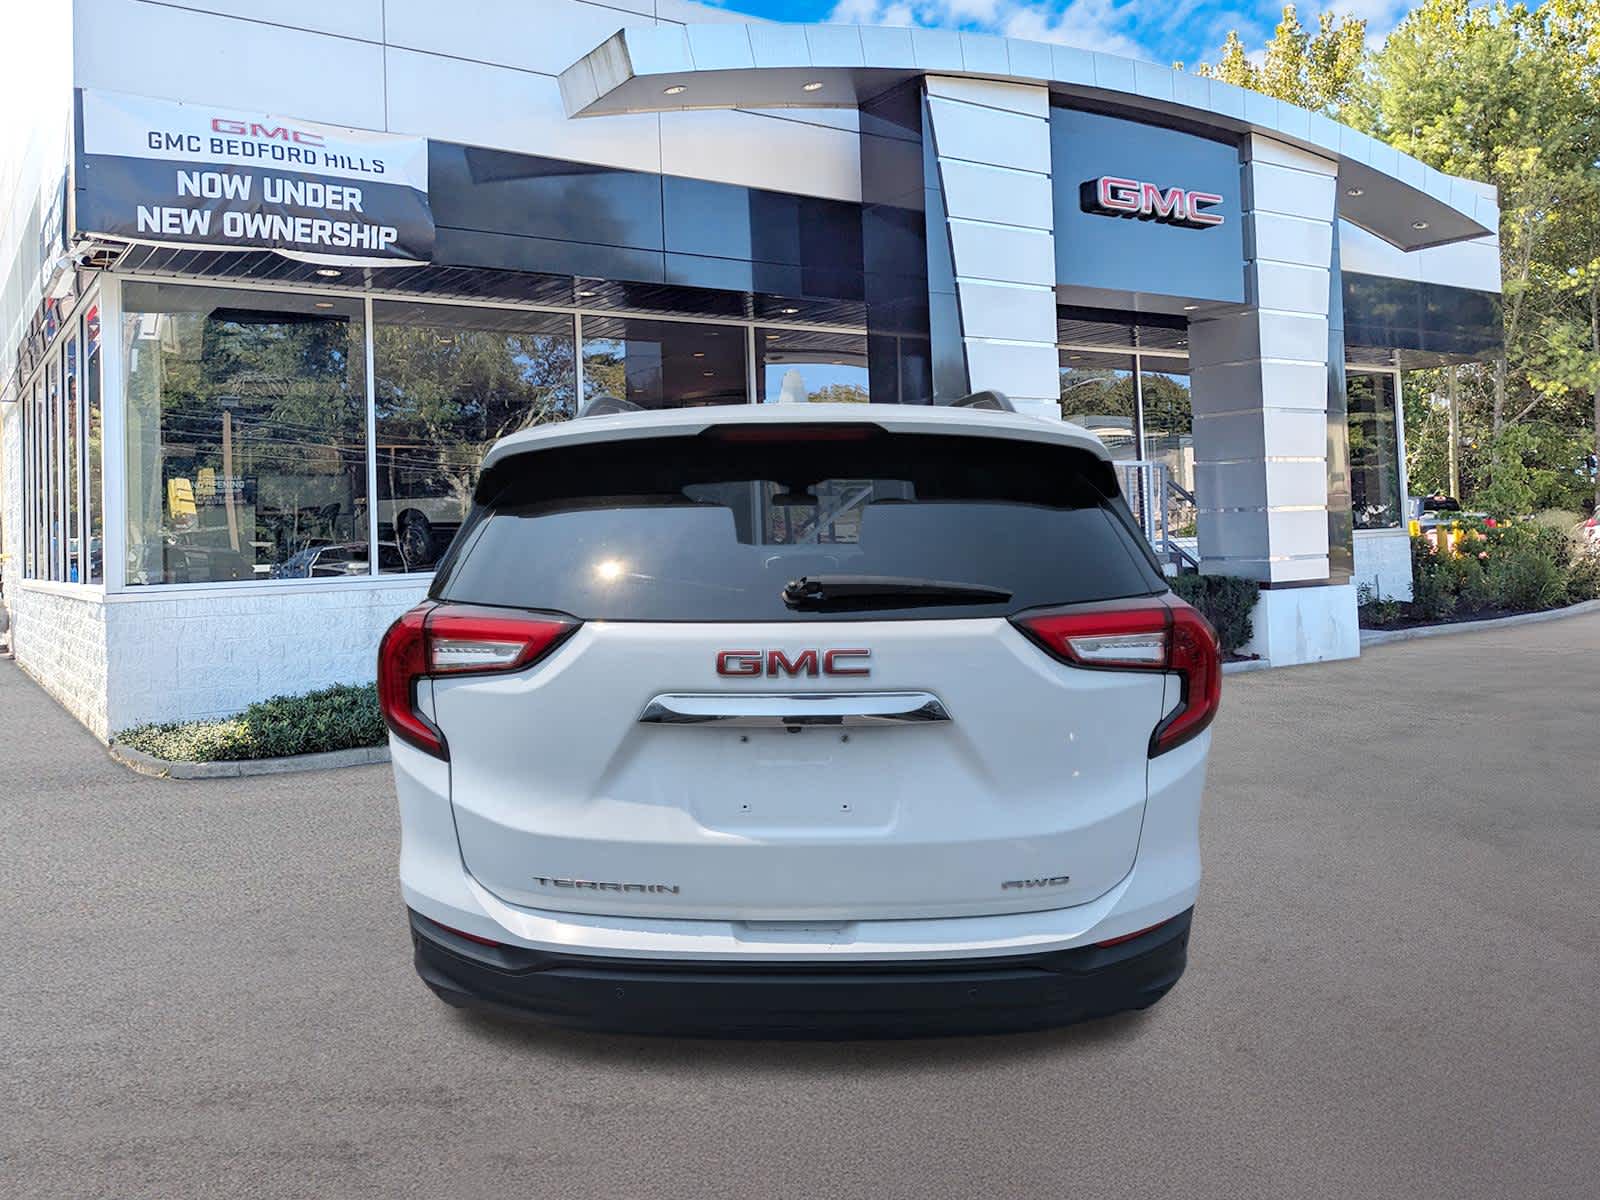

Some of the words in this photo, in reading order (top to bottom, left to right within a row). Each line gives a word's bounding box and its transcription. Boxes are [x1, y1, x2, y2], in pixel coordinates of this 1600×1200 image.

[211, 118, 326, 148] GMC
[147, 131, 201, 153] GMC
[210, 137, 317, 165] BEDFORD
[324, 152, 385, 174] HILLS
[176, 170, 252, 201] NOW
[263, 176, 364, 213] UNDER
[1097, 175, 1225, 225] GMC
[136, 205, 212, 236] NEW
[223, 211, 398, 251] OWNERSHIP
[715, 648, 871, 679] GMC
[532, 875, 681, 895] TERRAIN
[1001, 875, 1070, 891] AWD
